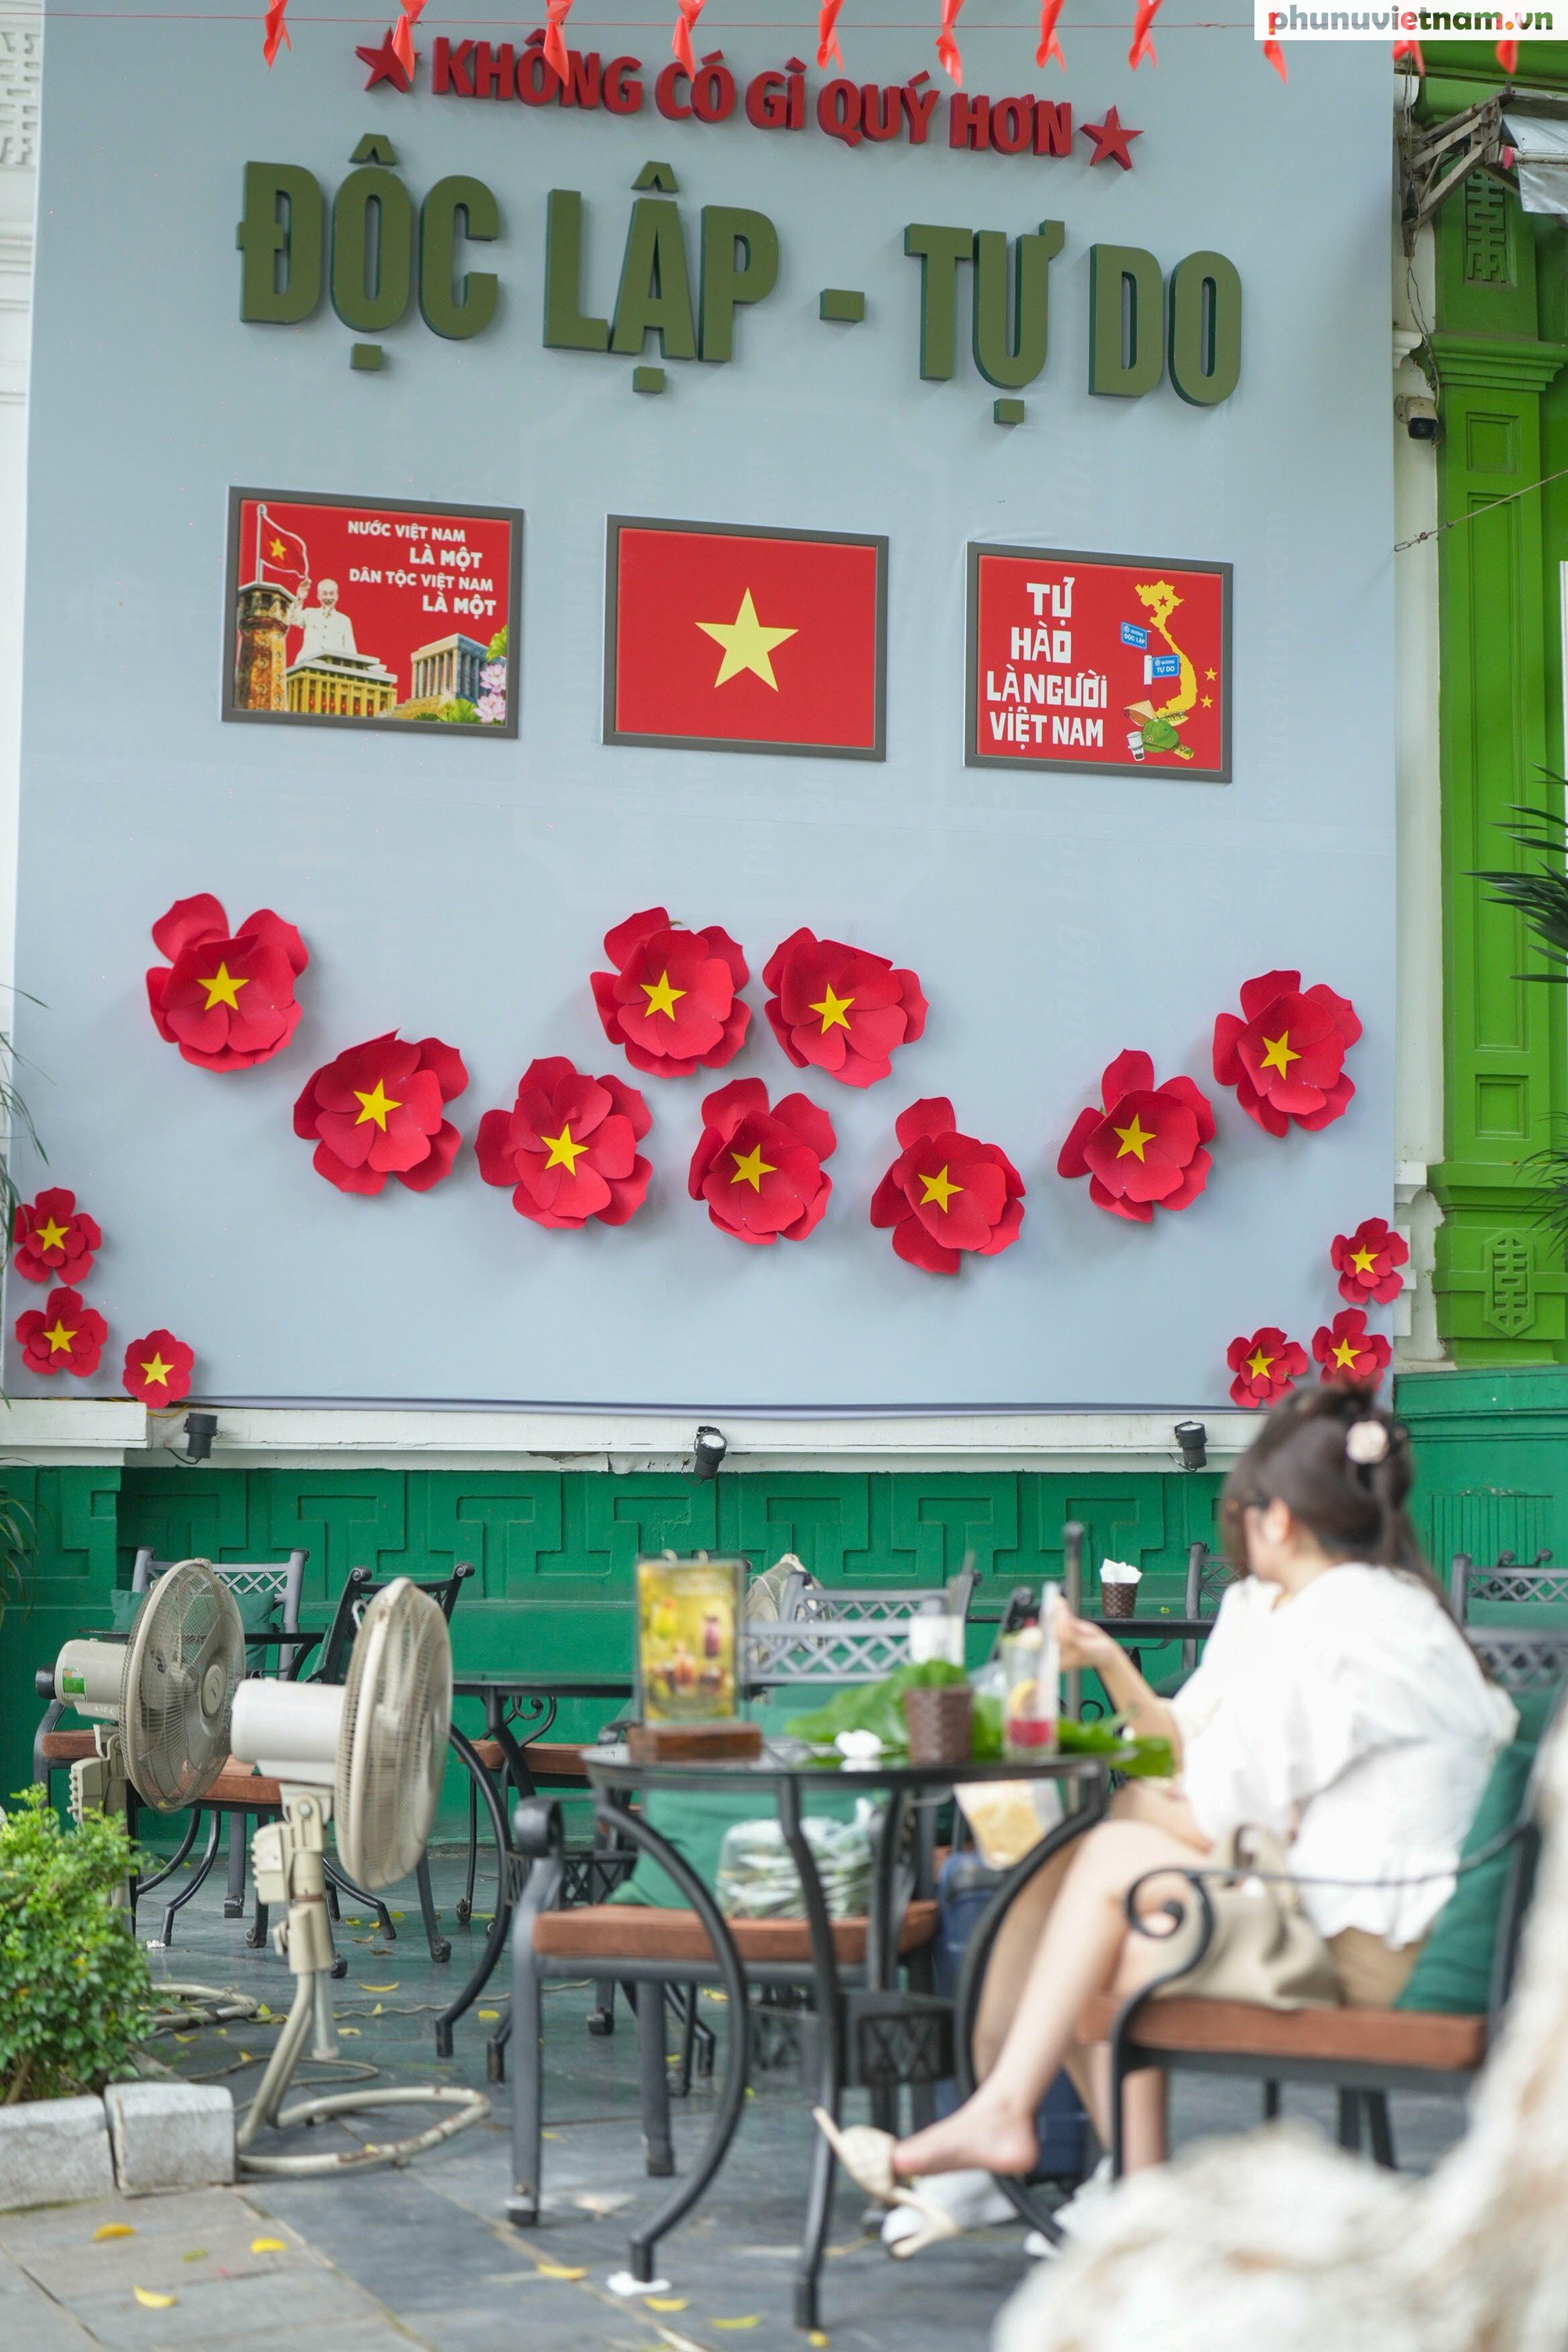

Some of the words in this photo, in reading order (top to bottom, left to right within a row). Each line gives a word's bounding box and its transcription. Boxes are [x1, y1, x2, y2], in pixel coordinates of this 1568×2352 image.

[433, 28, 642, 115] KHÔNG
[655, 49, 736, 124] CÓ
[746, 56, 807, 131] GÌ
[817, 70, 940, 147] QUÝ
[949, 93, 1072, 157] HƠN
[236, 132, 499, 370] ĐỘC
[543, 161, 779, 394] LẬP
[904, 220, 1065, 424] TỰ
[1088, 243, 1242, 407] DO
[347, 519, 390, 536] NƯỚC
[394, 523, 428, 541] VIỆT
[432, 528, 465, 543] NAM
[349, 566, 382, 583] DÂN
[385, 569, 417, 588] TỘC
[420, 572, 455, 590] VIỆT
[459, 576, 493, 592] NAM
[409, 543, 435, 565] LÀ
[440, 546, 483, 572] MỘT
[423, 590, 448, 613] LÀ
[453, 593, 497, 620] MỘT
[1026, 576, 1075, 626] TỰ
[1011, 620, 1072, 664] HÀO
[989, 706, 1047, 750] VIỆT
[1052, 716, 1104, 747] NAM
